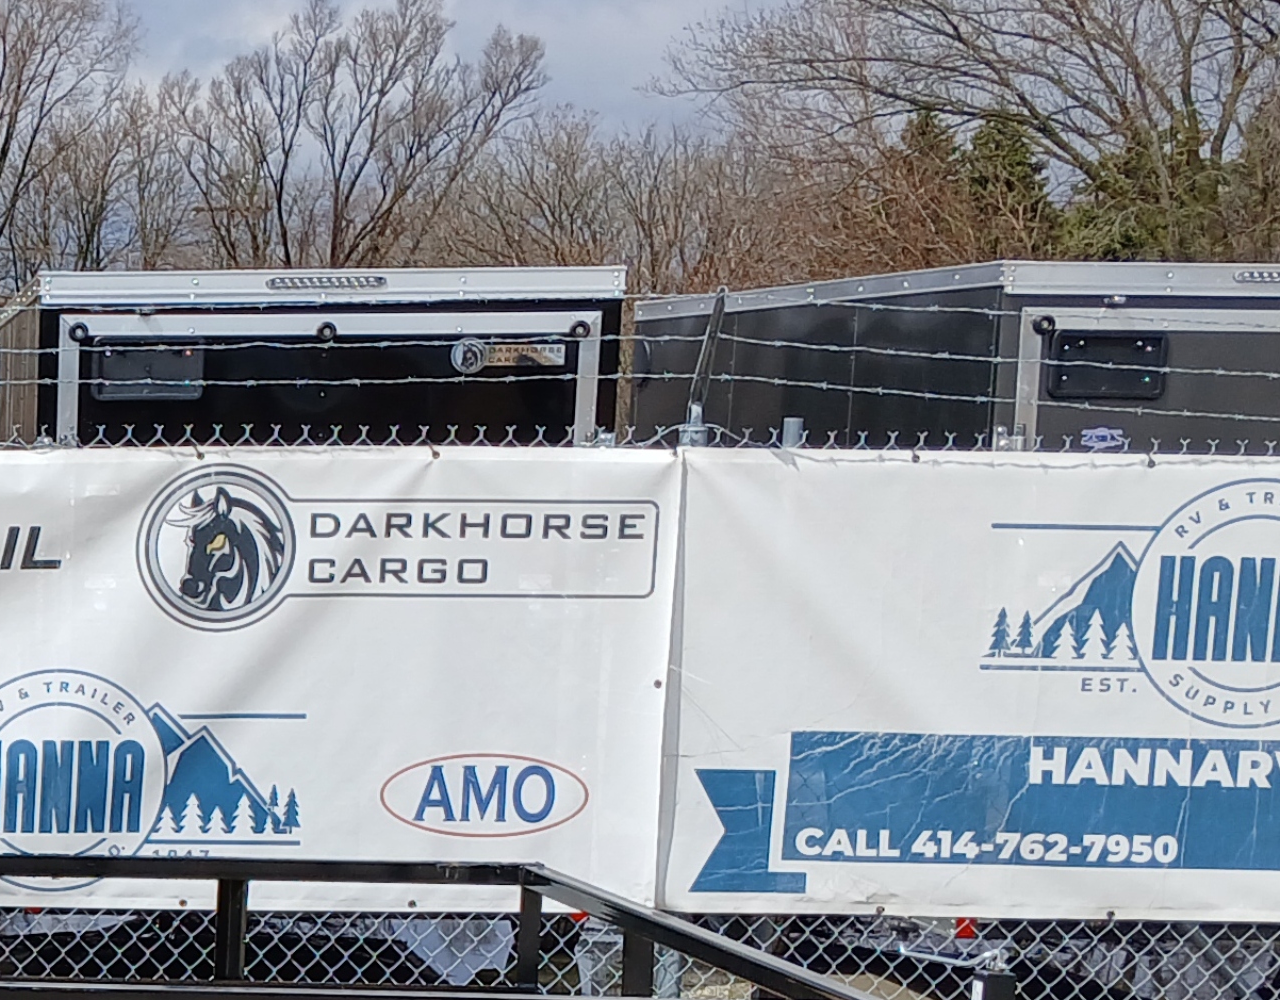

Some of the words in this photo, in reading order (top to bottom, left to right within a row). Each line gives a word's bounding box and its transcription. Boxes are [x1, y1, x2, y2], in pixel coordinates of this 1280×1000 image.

[309, 511, 647, 541] DARKHORSE
[1174, 511, 1203, 539] RV
[1217, 498, 1231, 512] &
[1245, 491, 1280, 505] TR
[307, 557, 489, 584] CARGO
[1151, 555, 1280, 663] HAN
[17, 687, 30, 700] &
[42, 680, 137, 725] TRAILER
[1080, 676, 1138, 693] EST.
[1168, 673, 1272, 716] SUPPLY
[413, 764, 557, 824] AMO
[794, 827, 901, 858] CALL
[910, 829, 1179, 864] 414-762-7950
